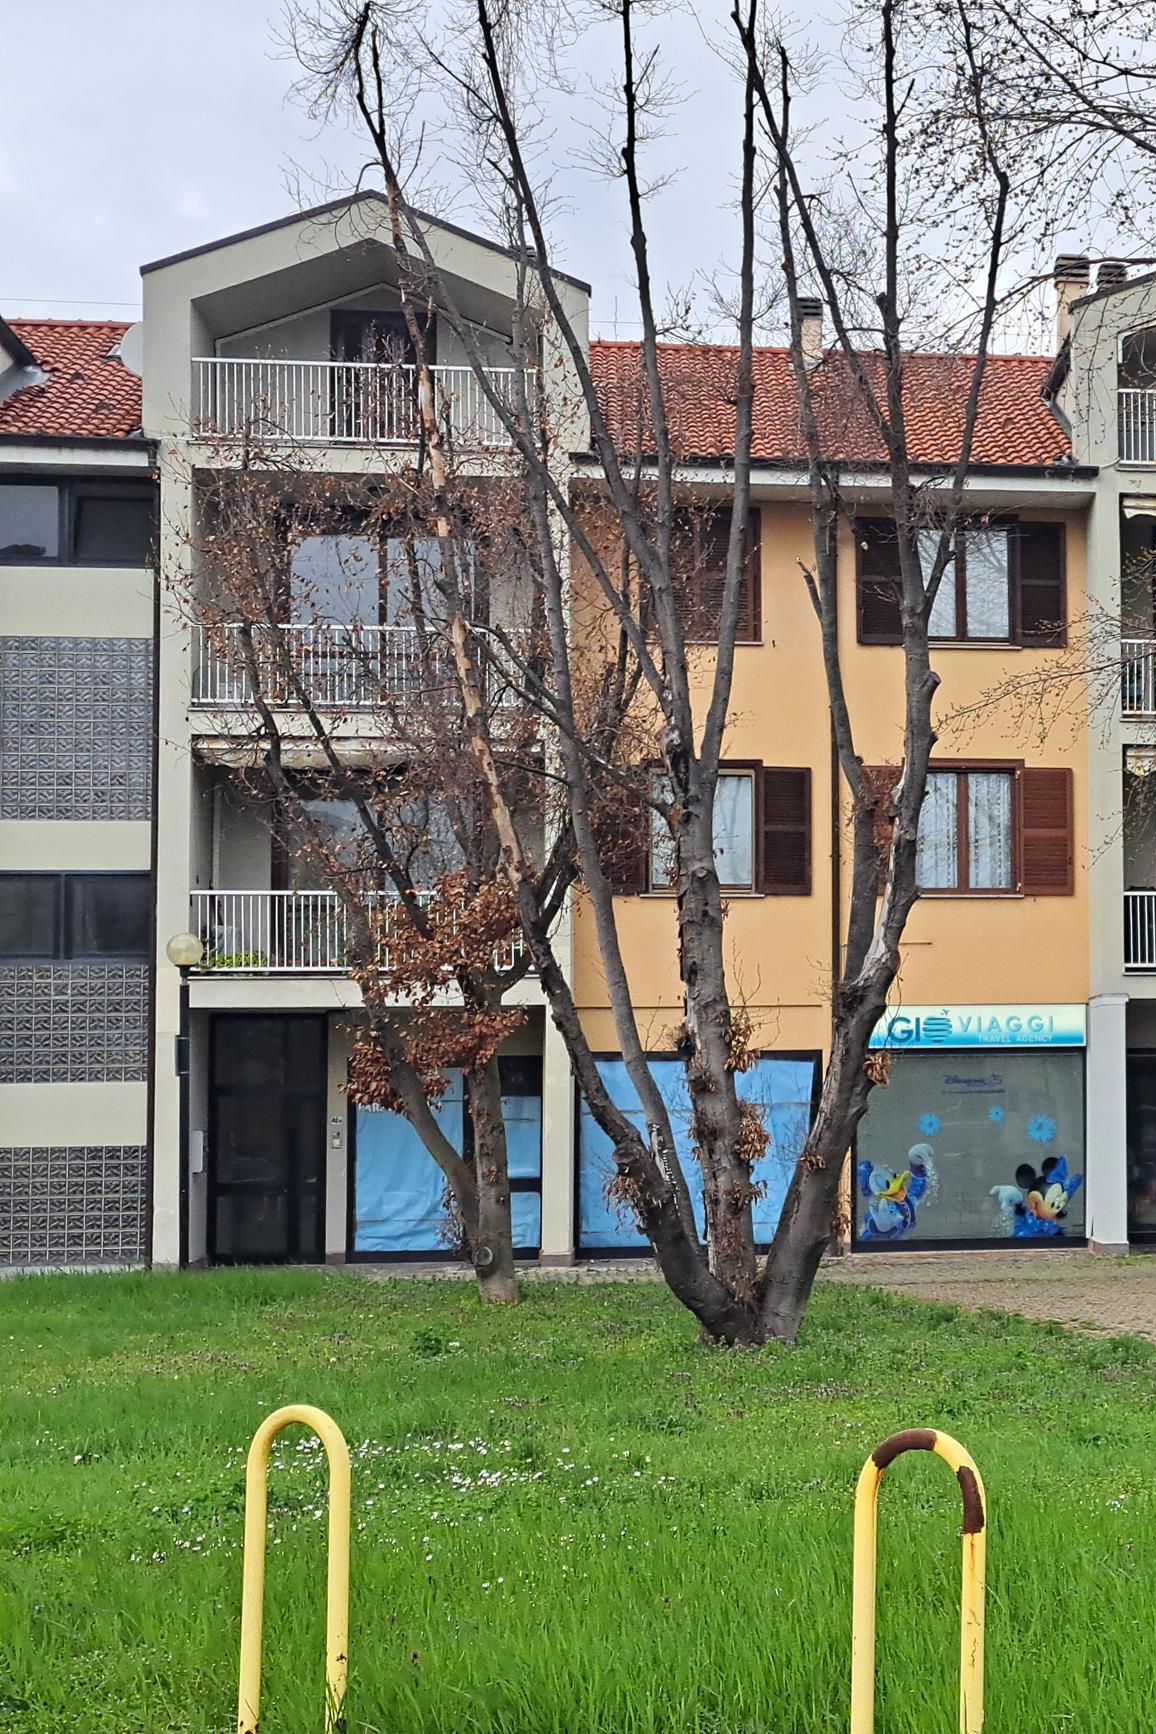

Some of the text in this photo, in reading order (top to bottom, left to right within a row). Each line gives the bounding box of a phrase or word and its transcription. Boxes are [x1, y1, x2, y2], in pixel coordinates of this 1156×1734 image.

[958, 1015, 1054, 1033] VIAGGI
[978, 1034, 1054, 1043] TRAVEL AGENCY
